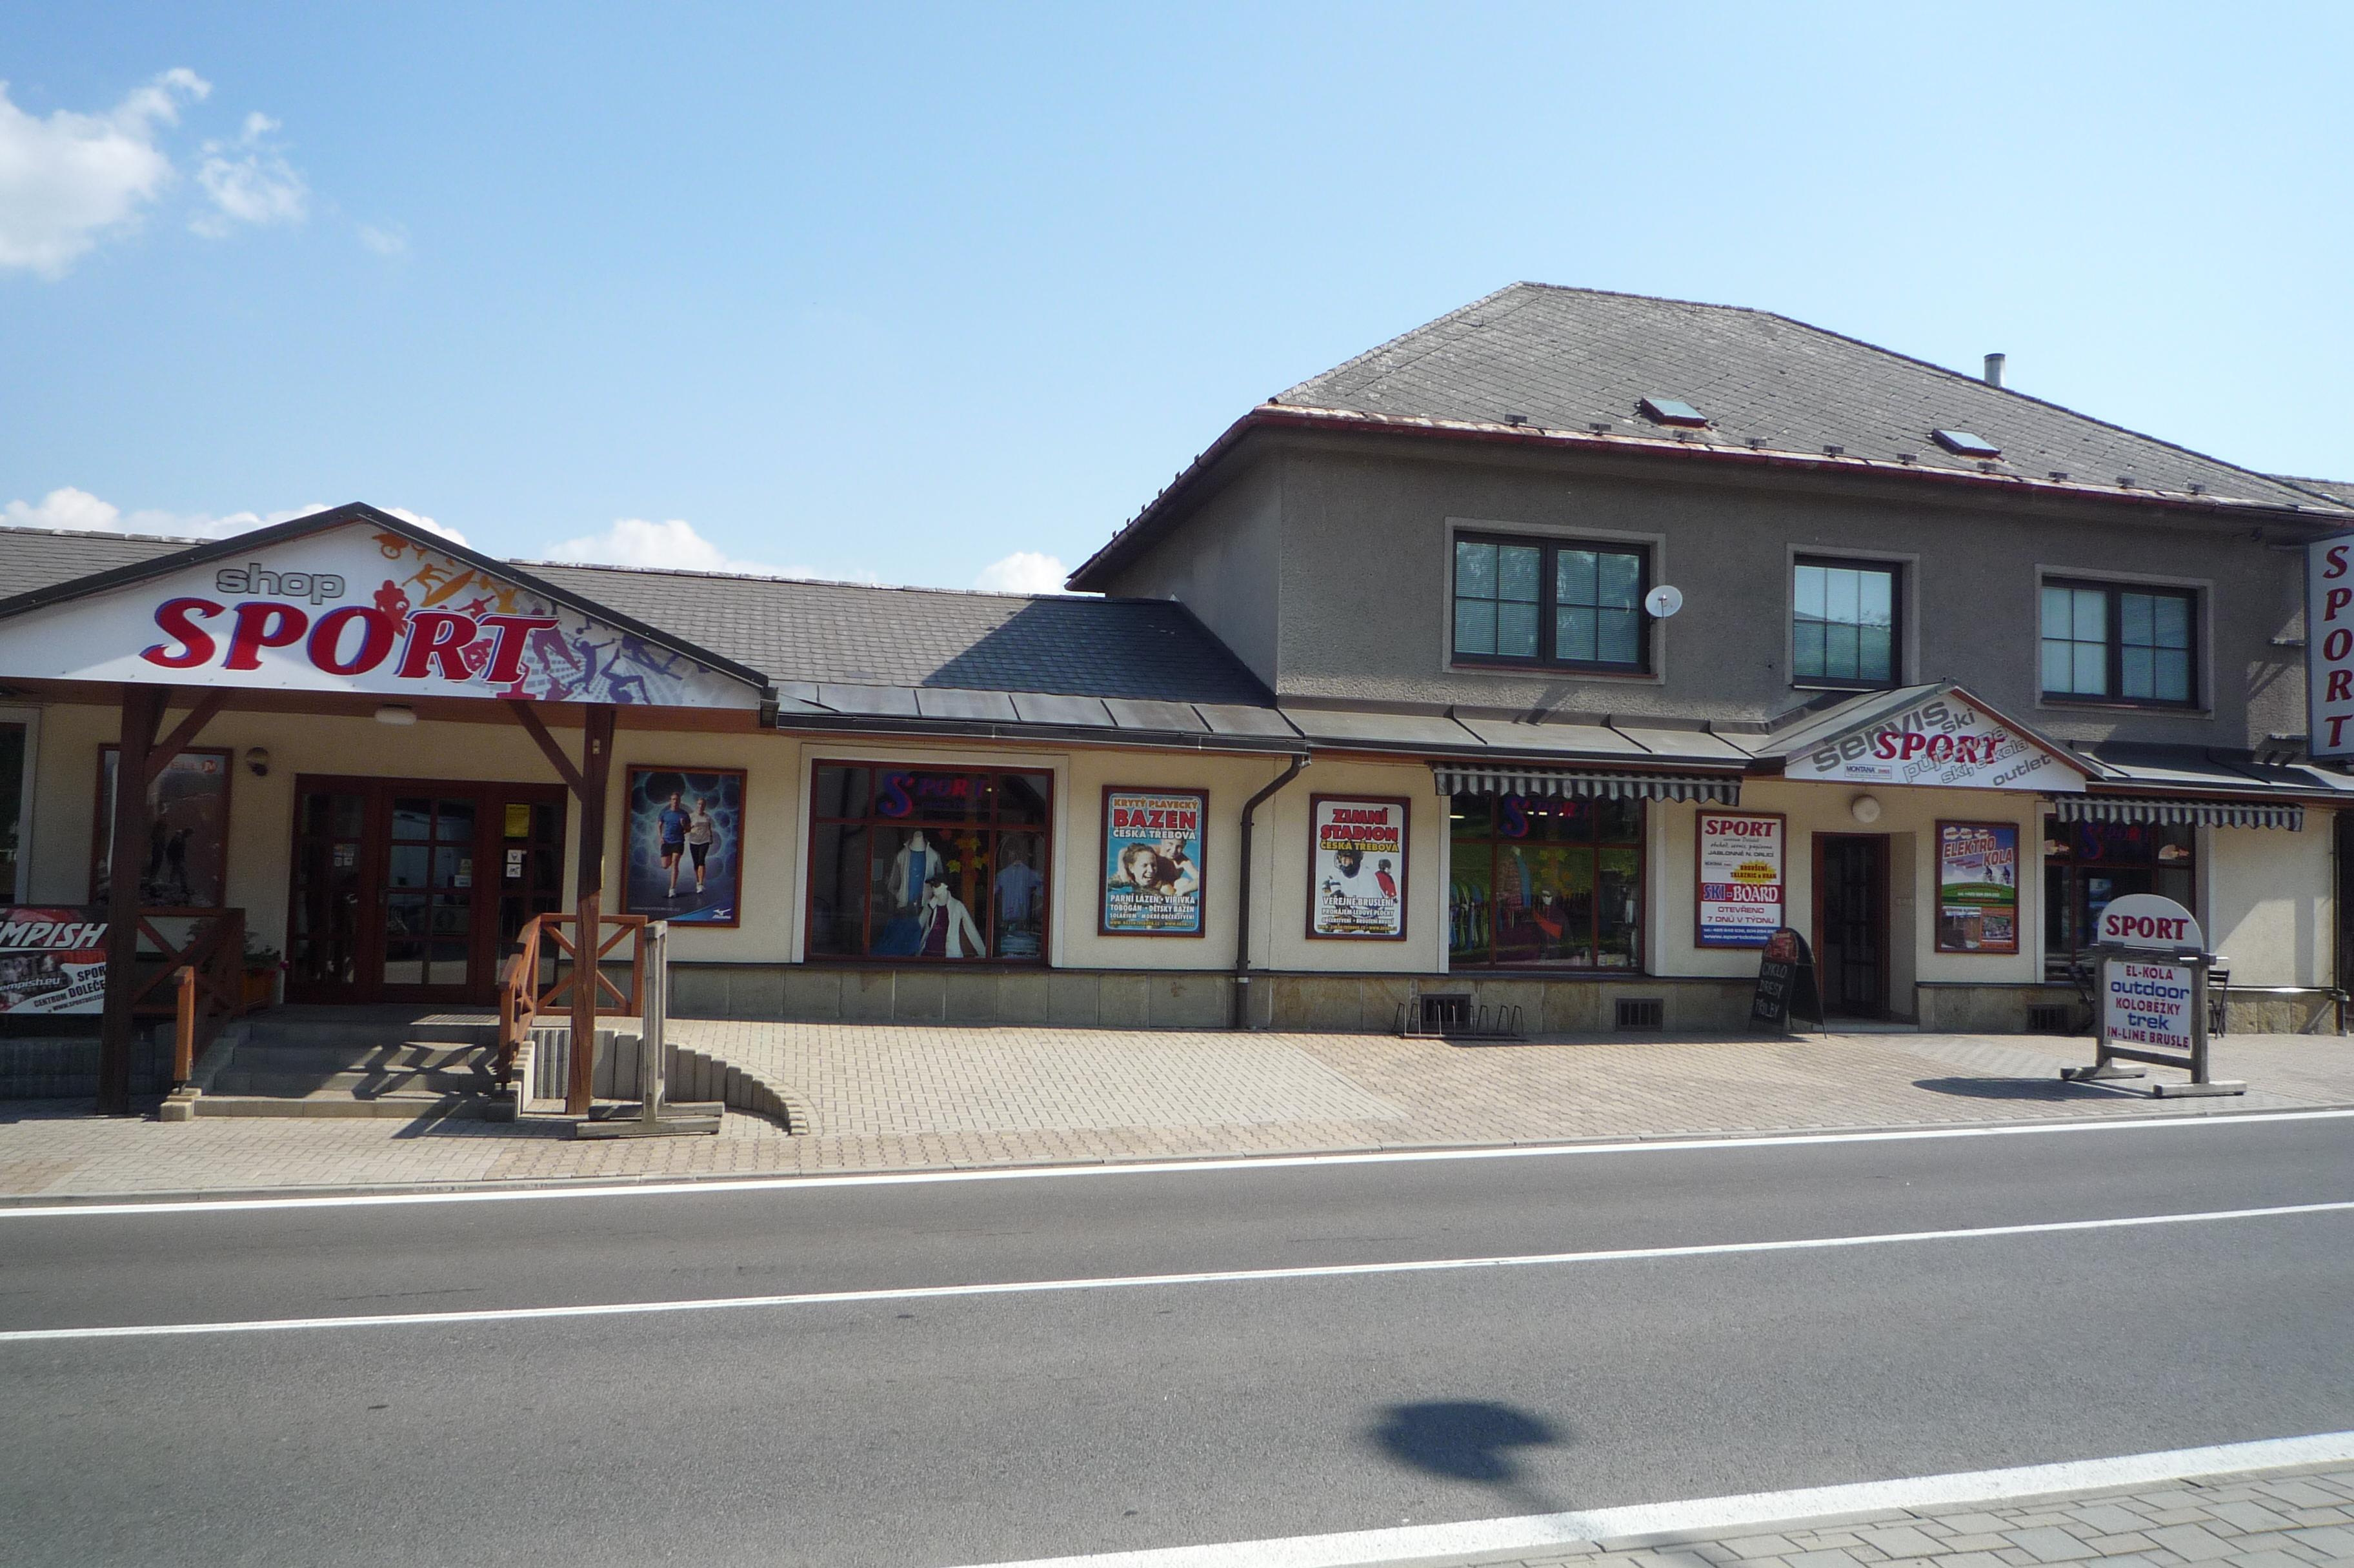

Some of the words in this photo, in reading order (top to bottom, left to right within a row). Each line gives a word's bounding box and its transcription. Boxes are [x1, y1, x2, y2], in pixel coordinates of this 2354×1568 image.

[216, 563, 346, 605] shop
[139, 597, 560, 685] SPORT
[2322, 545, 2354, 749] SPORT
[1940, 709, 1976, 734] ski
[1873, 731, 2007, 765] SPORT
[1993, 754, 2052, 787] outlet
[1114, 797, 1147, 807] KRYTÝ
[1148, 799, 1199, 810] PLAVECKÝ
[1332, 807, 1388, 825] ZIMNÍ
[1112, 827, 1147, 838] ČESKÁ
[1149, 828, 1197, 840] TŘEBOVÁ
[1320, 825, 1399, 841] STADION
[1704, 819, 1776, 837] SPORT
[1320, 840, 1353, 850] ČESKÁ
[1354, 841, 1399, 852] TŘEBOVÁ
[1944, 837, 1996, 858] ELEKTRO
[1983, 849, 2013, 866] KOLA
[1111, 894, 1134, 903] PARNÍ
[1323, 896, 1357, 906] VEŘEJNÉ
[1717, 905, 1765, 914] OTEVŘENO
[1745, 915, 1775, 923] TÝDNU
[2106, 914, 2189, 940] SPORT
[0, 921, 108, 950] MPISH
[2126, 965, 2174, 981] EL-KOLA
[2111, 981, 2190, 1000] outdoor
[34, 993, 67, 1007] CENTRUM
[2127, 1012, 2169, 1030] trek
[2107, 1026, 2146, 1041] IN-LINE
[2149, 1031, 2189, 1049] BRUSLE
